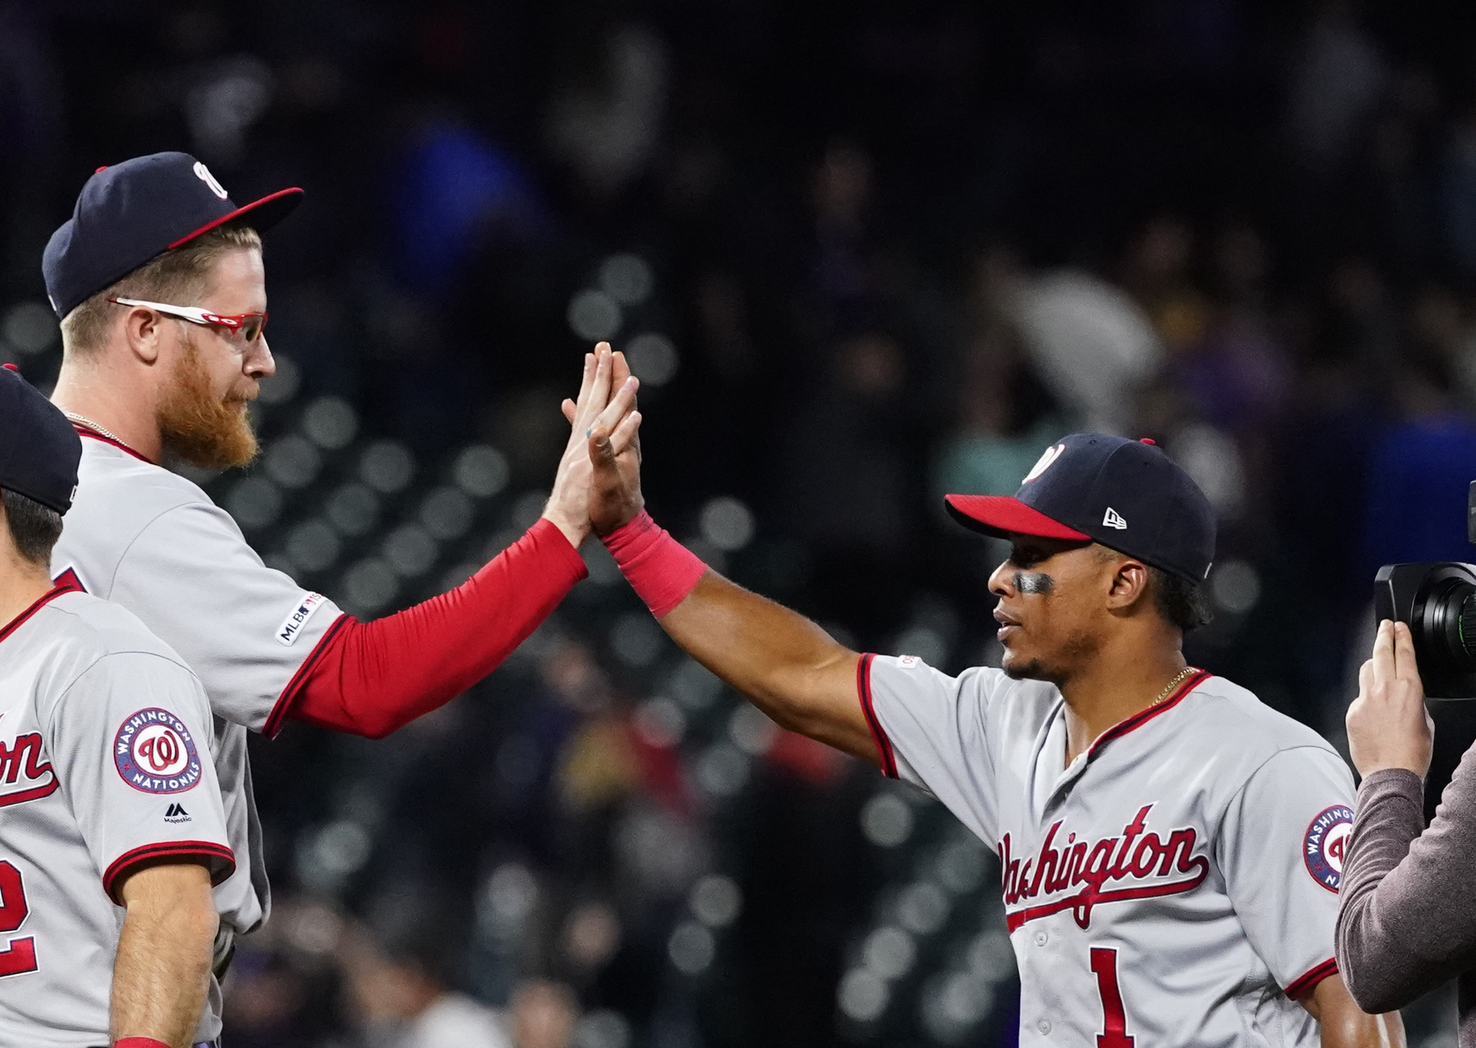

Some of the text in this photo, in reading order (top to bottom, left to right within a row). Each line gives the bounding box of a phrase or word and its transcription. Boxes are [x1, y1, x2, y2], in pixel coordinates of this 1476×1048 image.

[280, 612, 304, 642] MLB
[117, 710, 191, 755] WASHINGTON
[132, 761, 200, 790] NATIONALS
